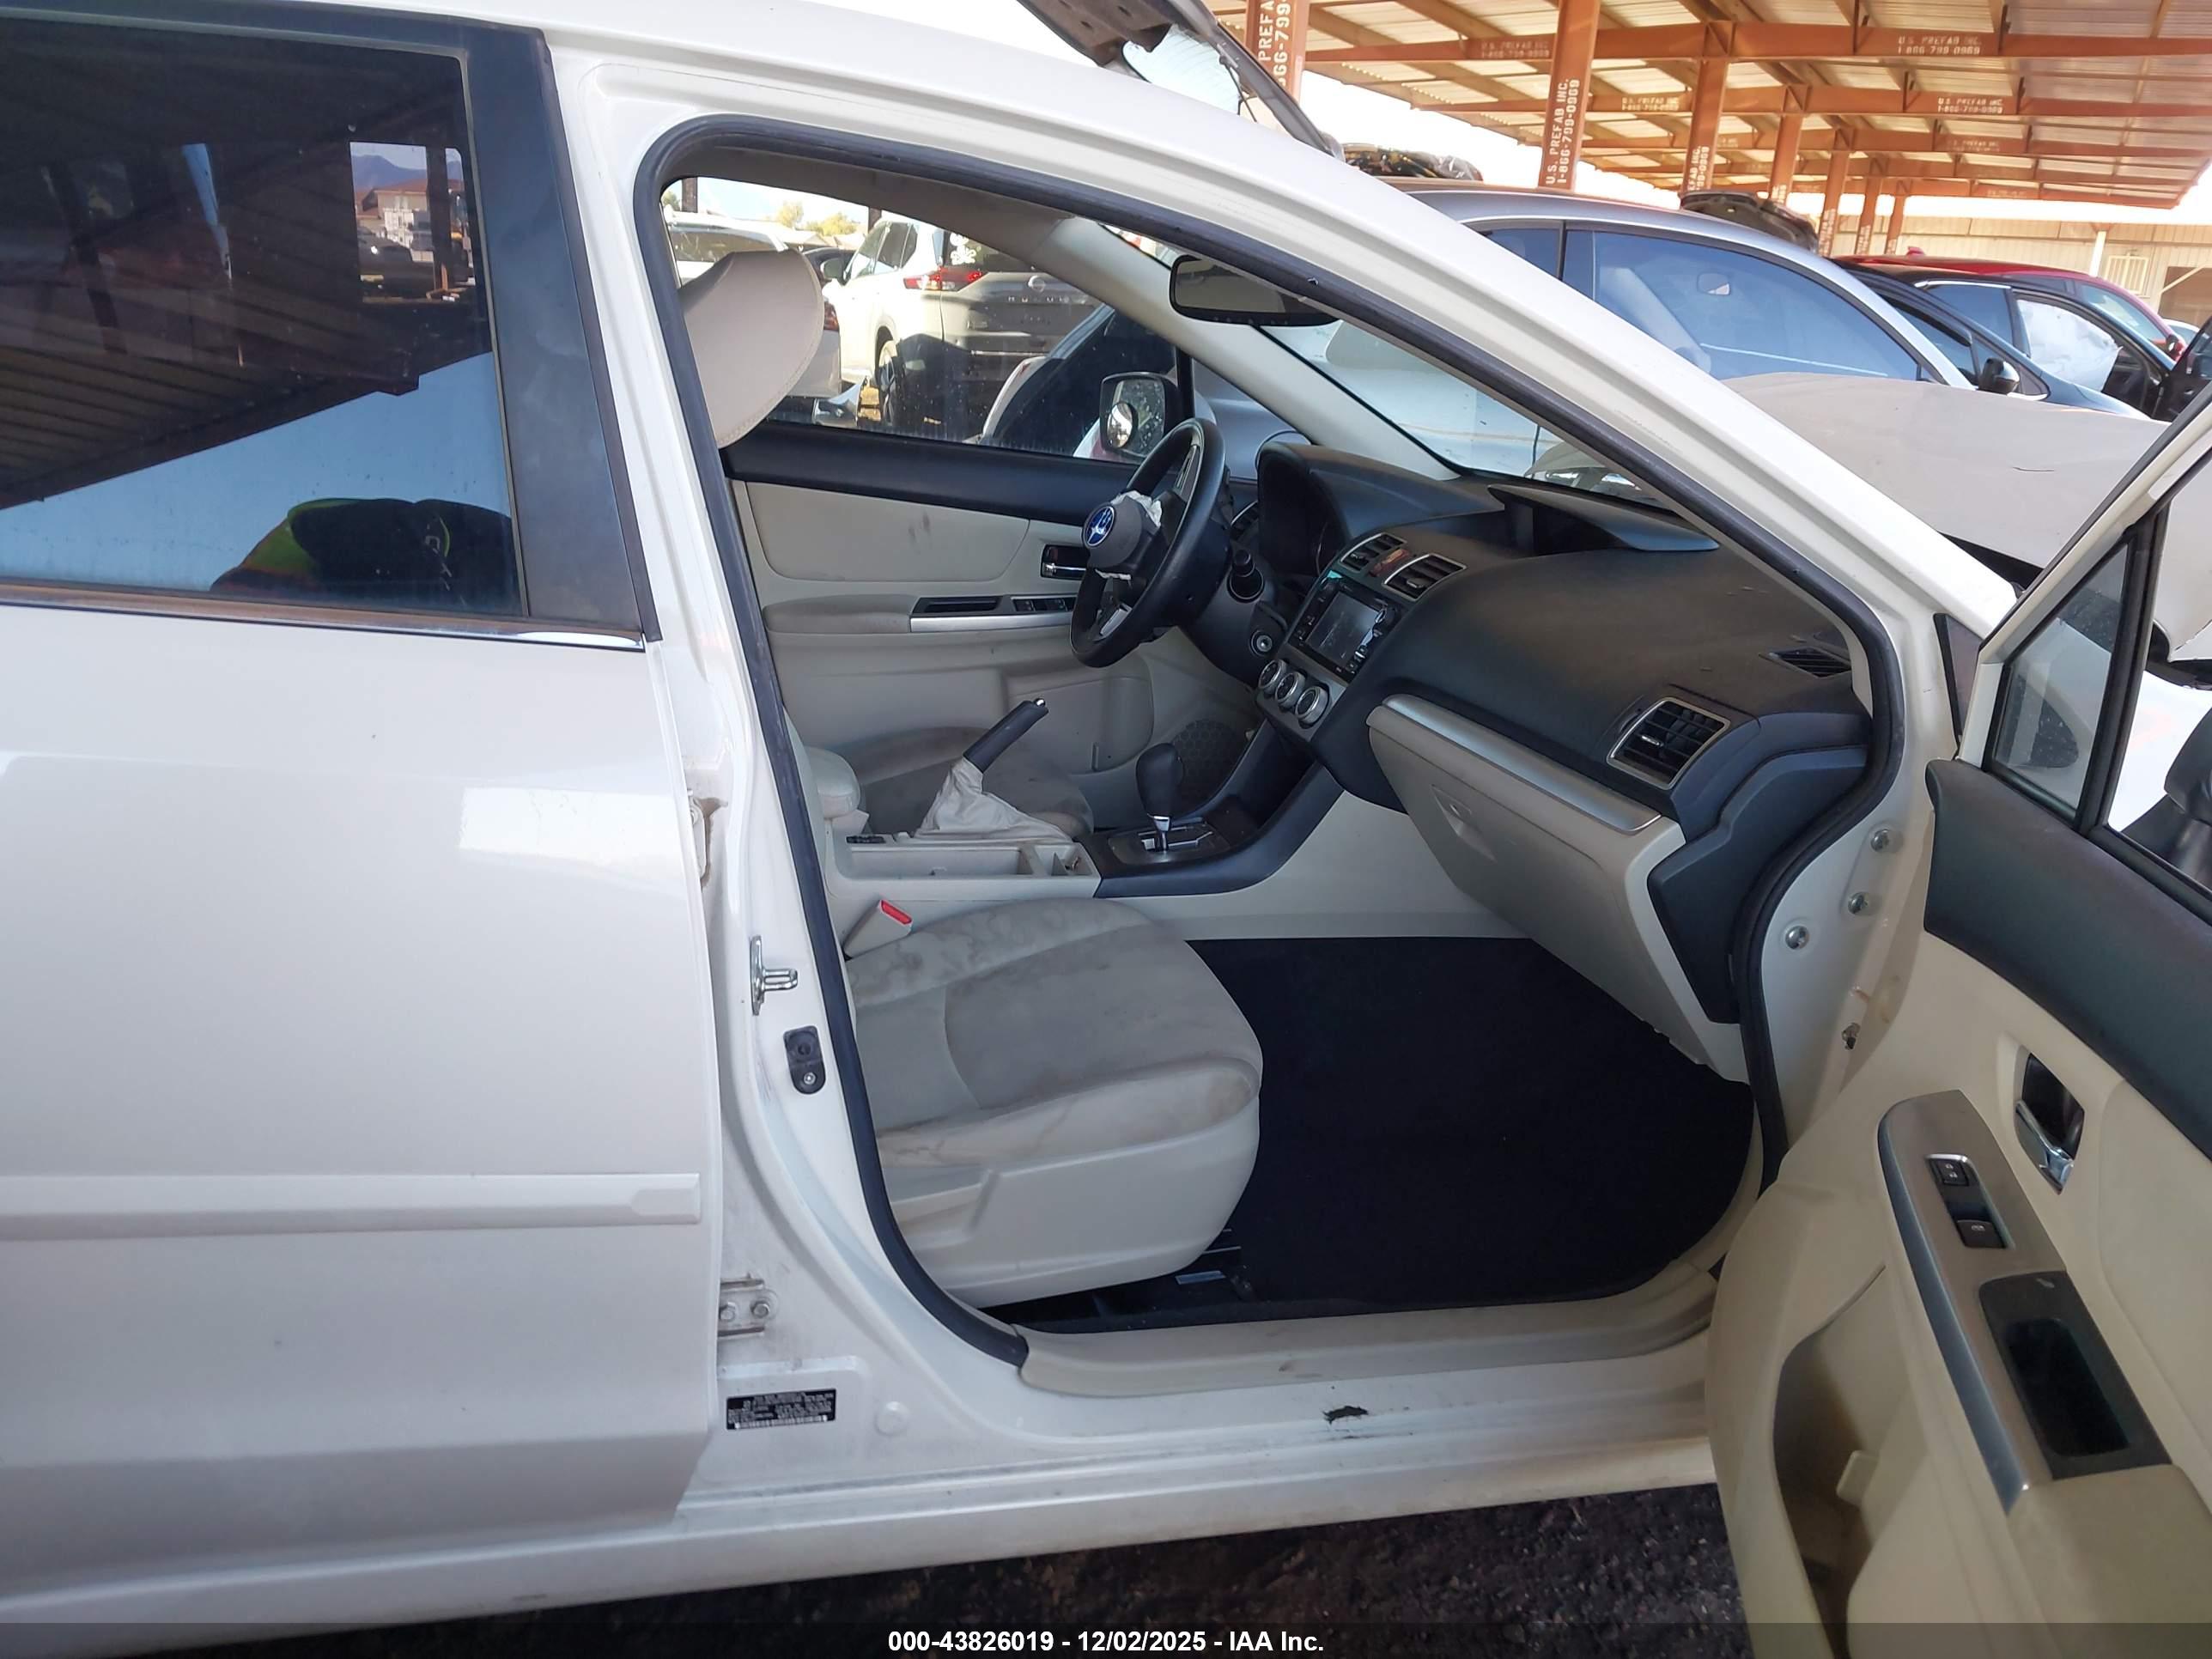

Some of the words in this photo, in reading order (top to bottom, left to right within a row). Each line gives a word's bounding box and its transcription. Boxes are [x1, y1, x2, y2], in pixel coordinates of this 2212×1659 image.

[1273, 0, 1291, 86] 66-799
[1557, 79, 1569, 102] INC.
[1550, 108, 1565, 155] PREFAB
[1546, 161, 1559, 184] U.S.
